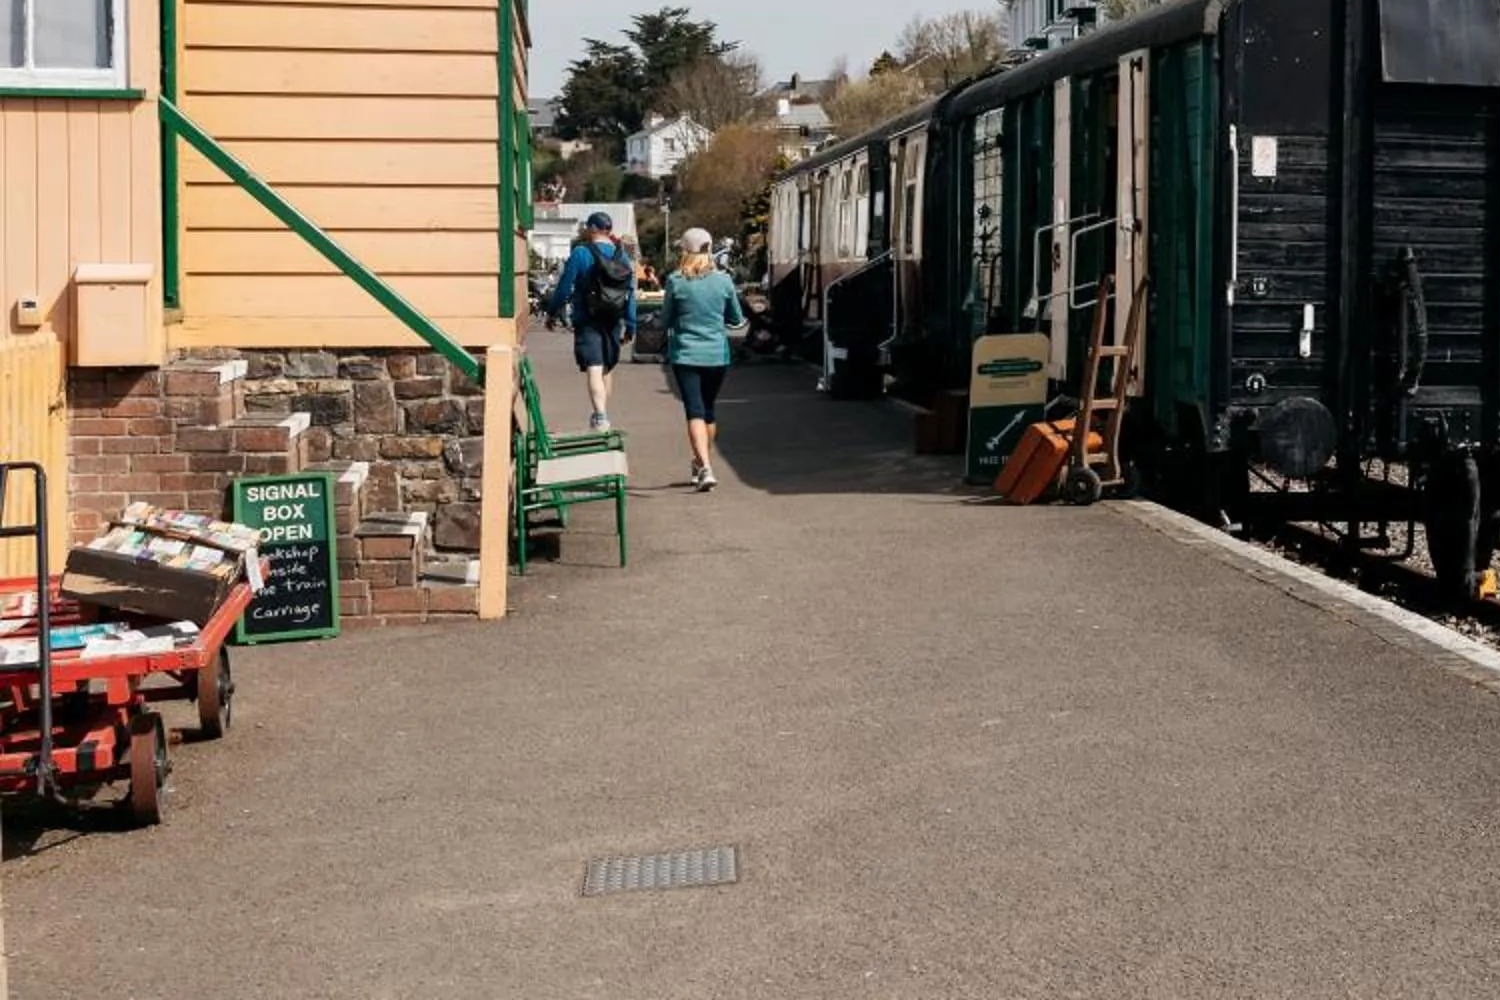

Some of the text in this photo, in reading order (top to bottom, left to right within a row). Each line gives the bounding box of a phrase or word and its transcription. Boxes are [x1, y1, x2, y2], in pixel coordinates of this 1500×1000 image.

[247, 483, 320, 502] SIGNAL
[263, 504, 305, 521] BOX
[259, 524, 313, 542] OPEN
[270, 561, 307, 577] nside
[283, 577, 327, 593] train
